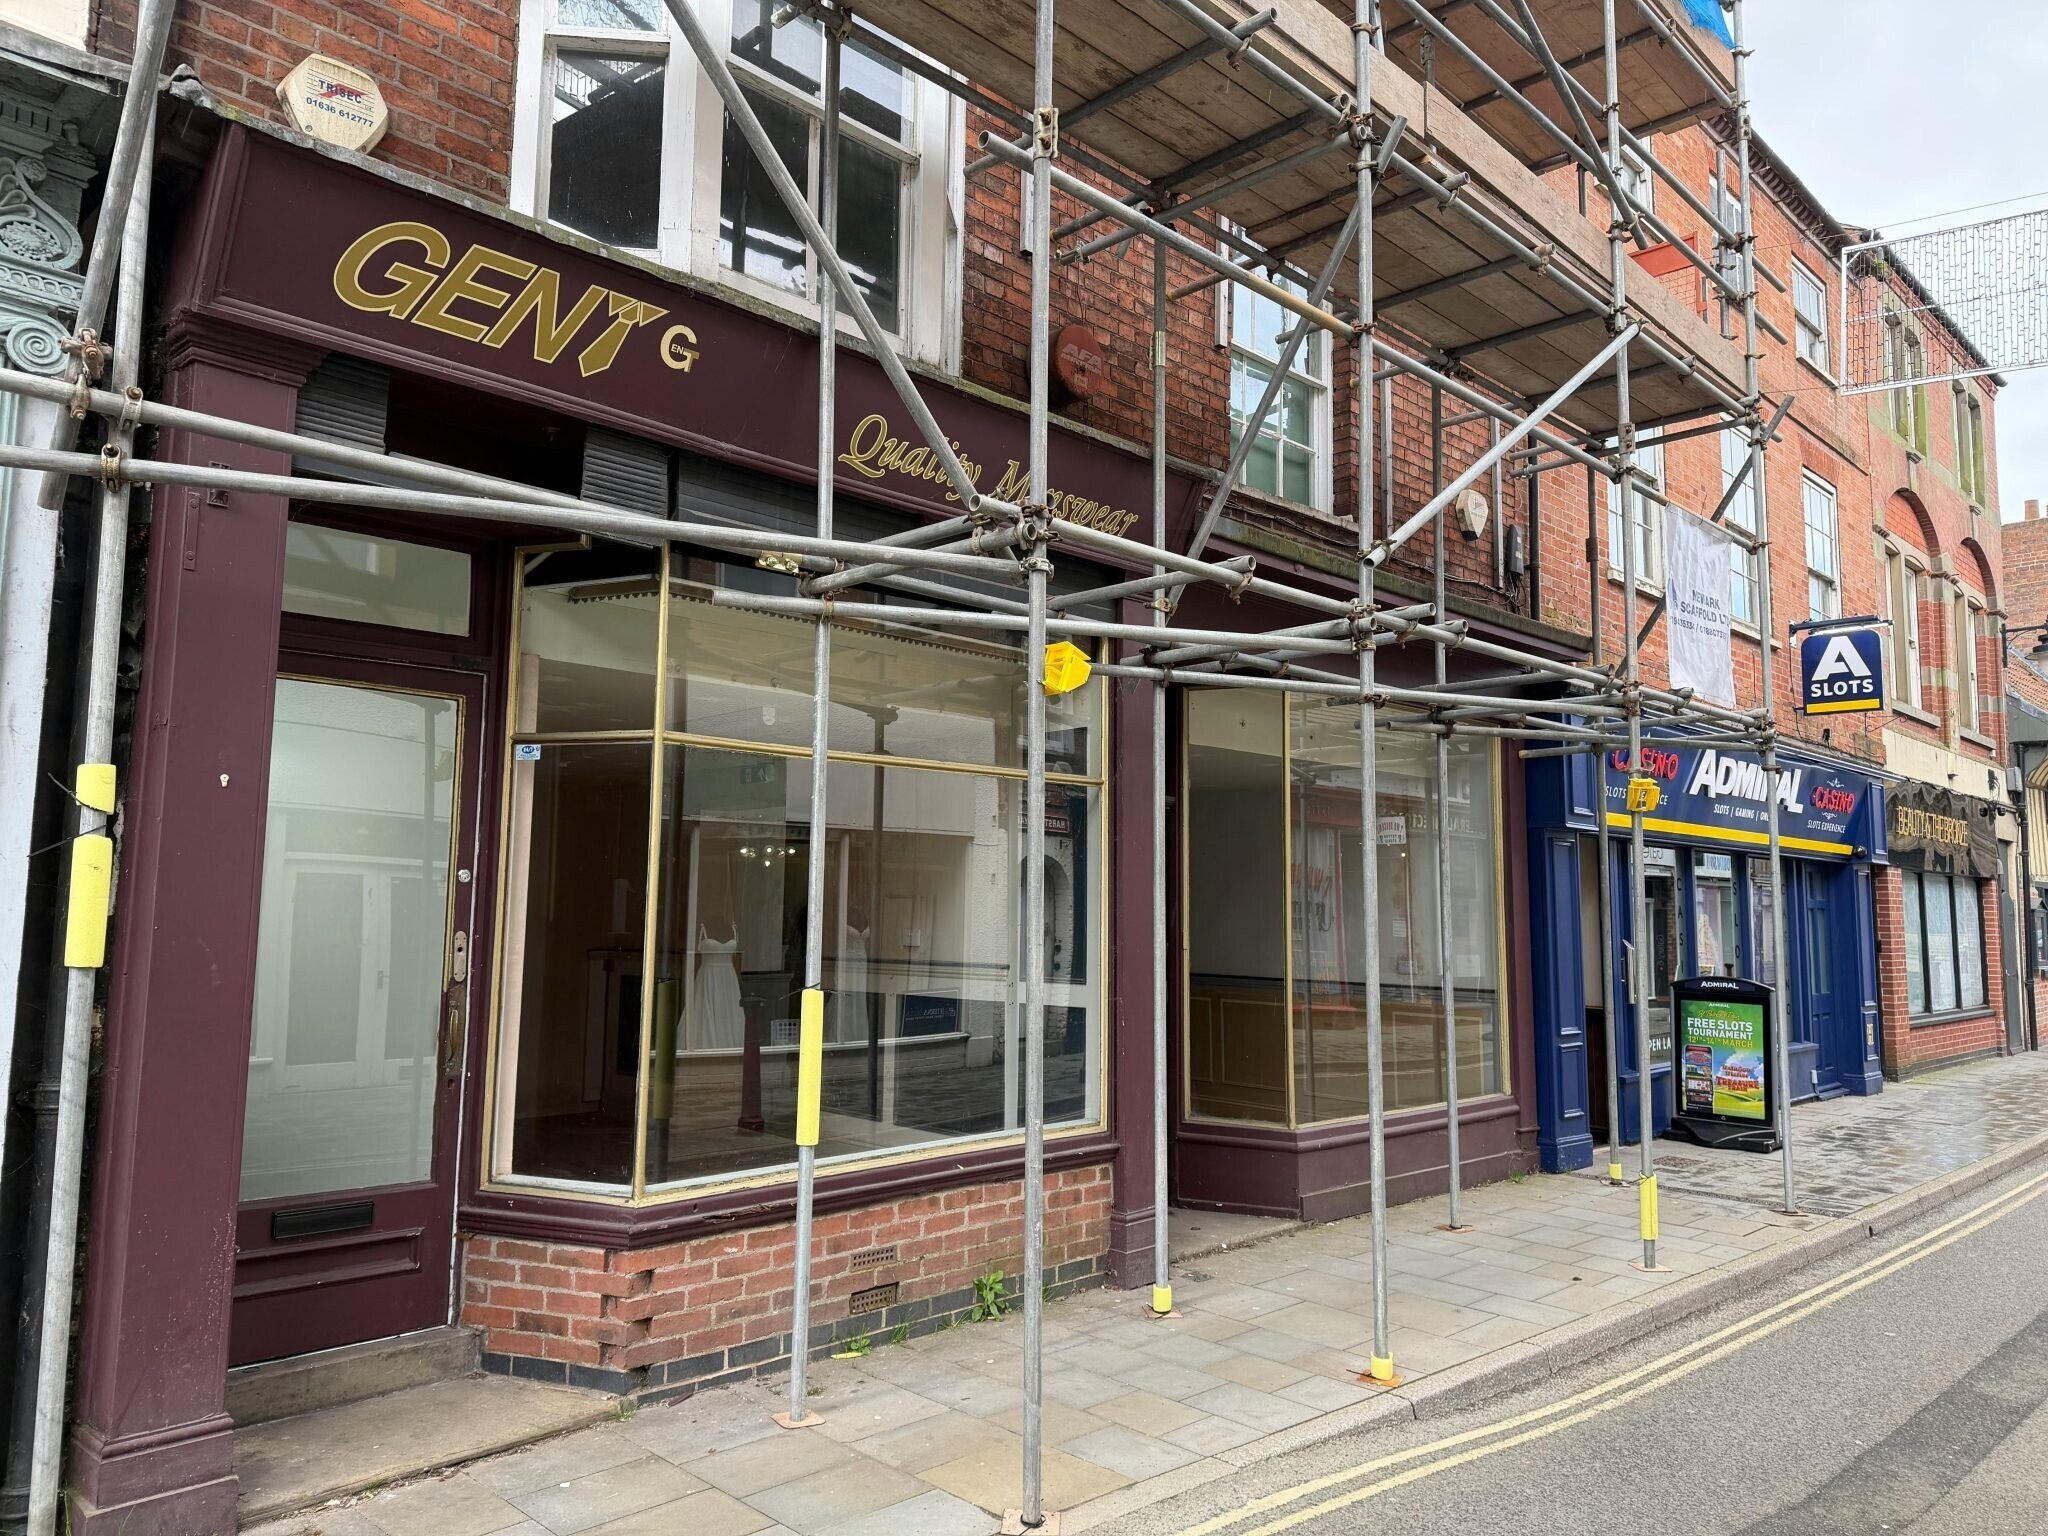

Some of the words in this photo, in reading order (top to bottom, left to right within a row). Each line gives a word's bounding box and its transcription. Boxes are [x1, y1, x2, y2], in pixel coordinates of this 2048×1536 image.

[319, 79, 362, 104] TRISEC
[338, 109, 374, 128] 612777
[997, 459, 1139, 538] Mnswear
[1811, 635, 1873, 681] A
[1811, 679, 1874, 698] SLOTS
[1613, 747, 1679, 780] CSINO
[1689, 748, 1804, 814] ADMIAL
[1605, 785, 1627, 799] SLOTS
[1815, 786, 1855, 815] CASINO
[1713, 803, 1729, 815] SLOTS
[1735, 807, 1755, 819] GAMING
[1807, 819, 1821, 830] SLOTS
[1700, 980, 1739, 990] ADMIRAL
[1687, 1017, 1716, 1029] FREE
[1717, 1020, 1753, 1032] SLOTS
[1687, 1027, 1754, 1041] TOURNAMENT
[1649, 1038, 1661, 1051] PEN
[1663, 1036, 1672, 1050] LA
[1722, 1038, 1753, 1049] MARCH
